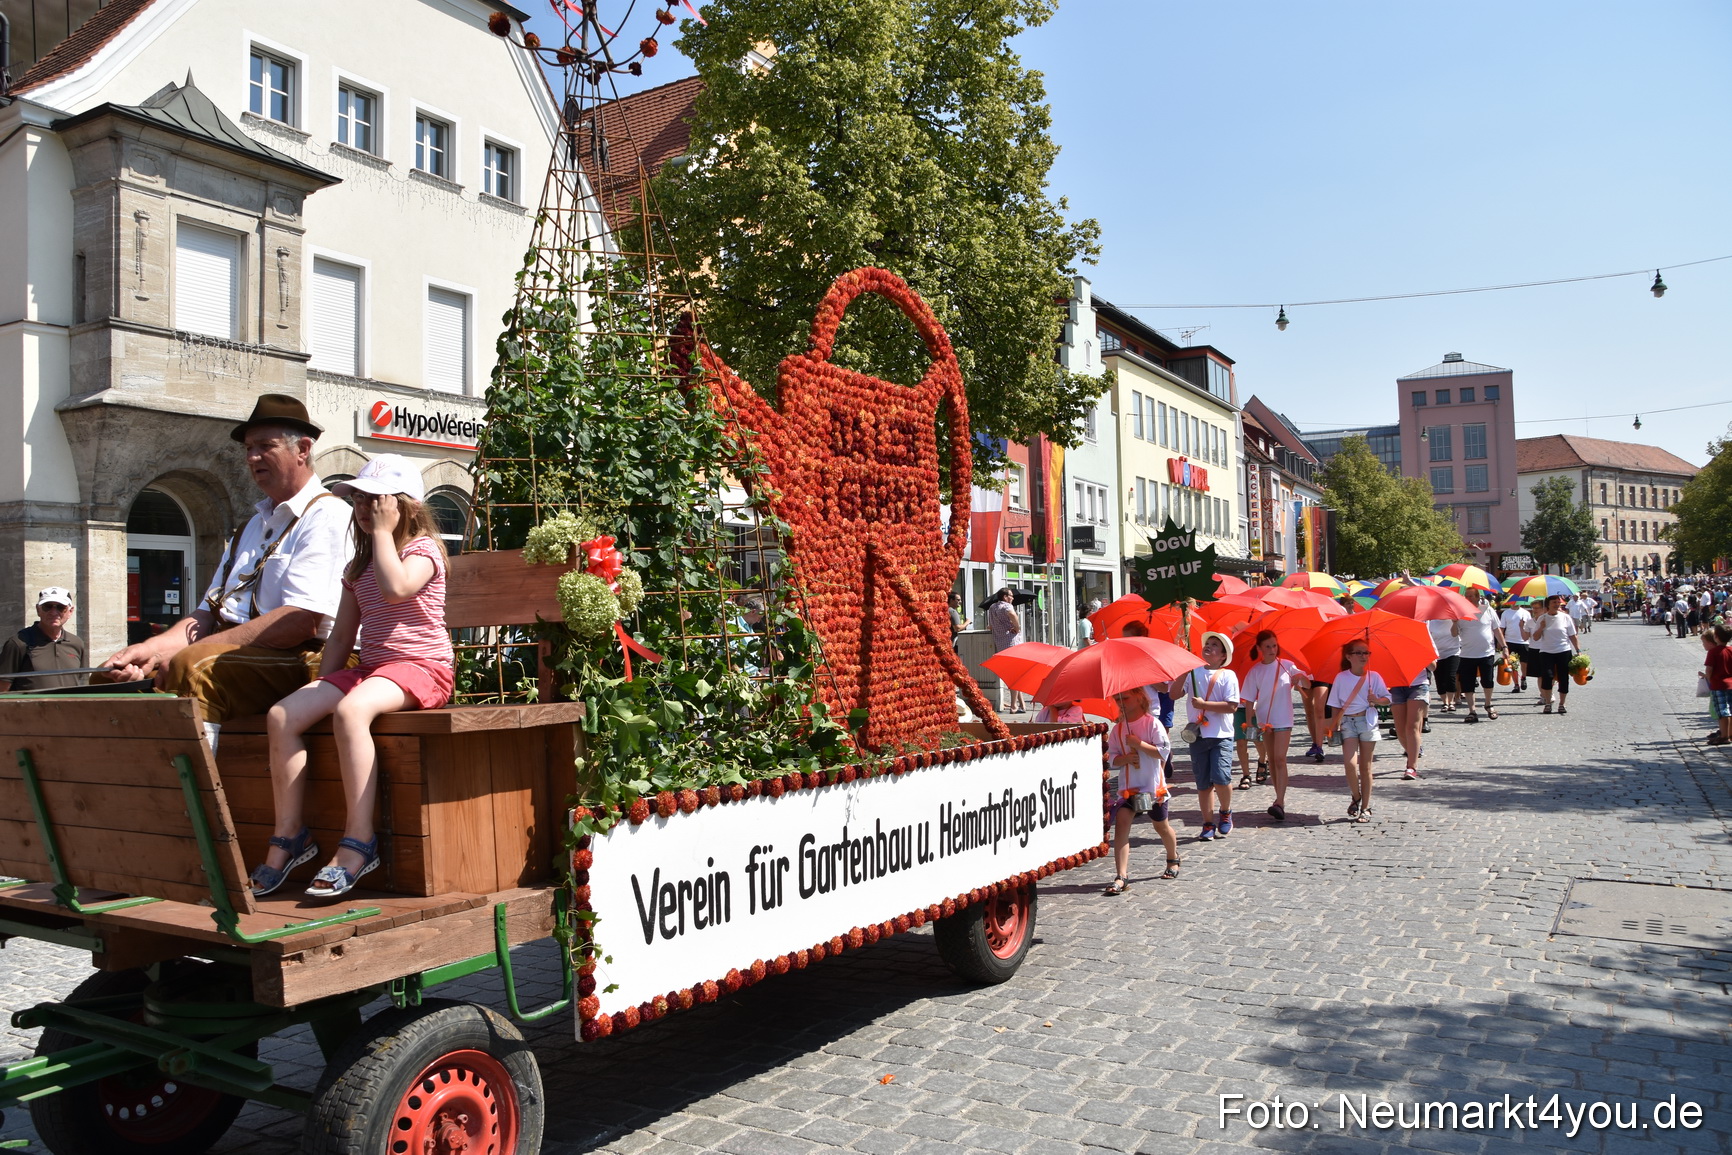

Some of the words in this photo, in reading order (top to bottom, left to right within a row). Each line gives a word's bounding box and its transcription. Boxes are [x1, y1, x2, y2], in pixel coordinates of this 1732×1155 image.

[1155, 534, 1191, 553] OGV
[631, 857, 731, 945] Verein
[745, 845, 789, 915] für
[798, 818, 912, 899] Gartenbau
[917, 822, 935, 862] u.
[939, 788, 1037, 856] Heimatpflege
[1039, 771, 1079, 829] Stauf
